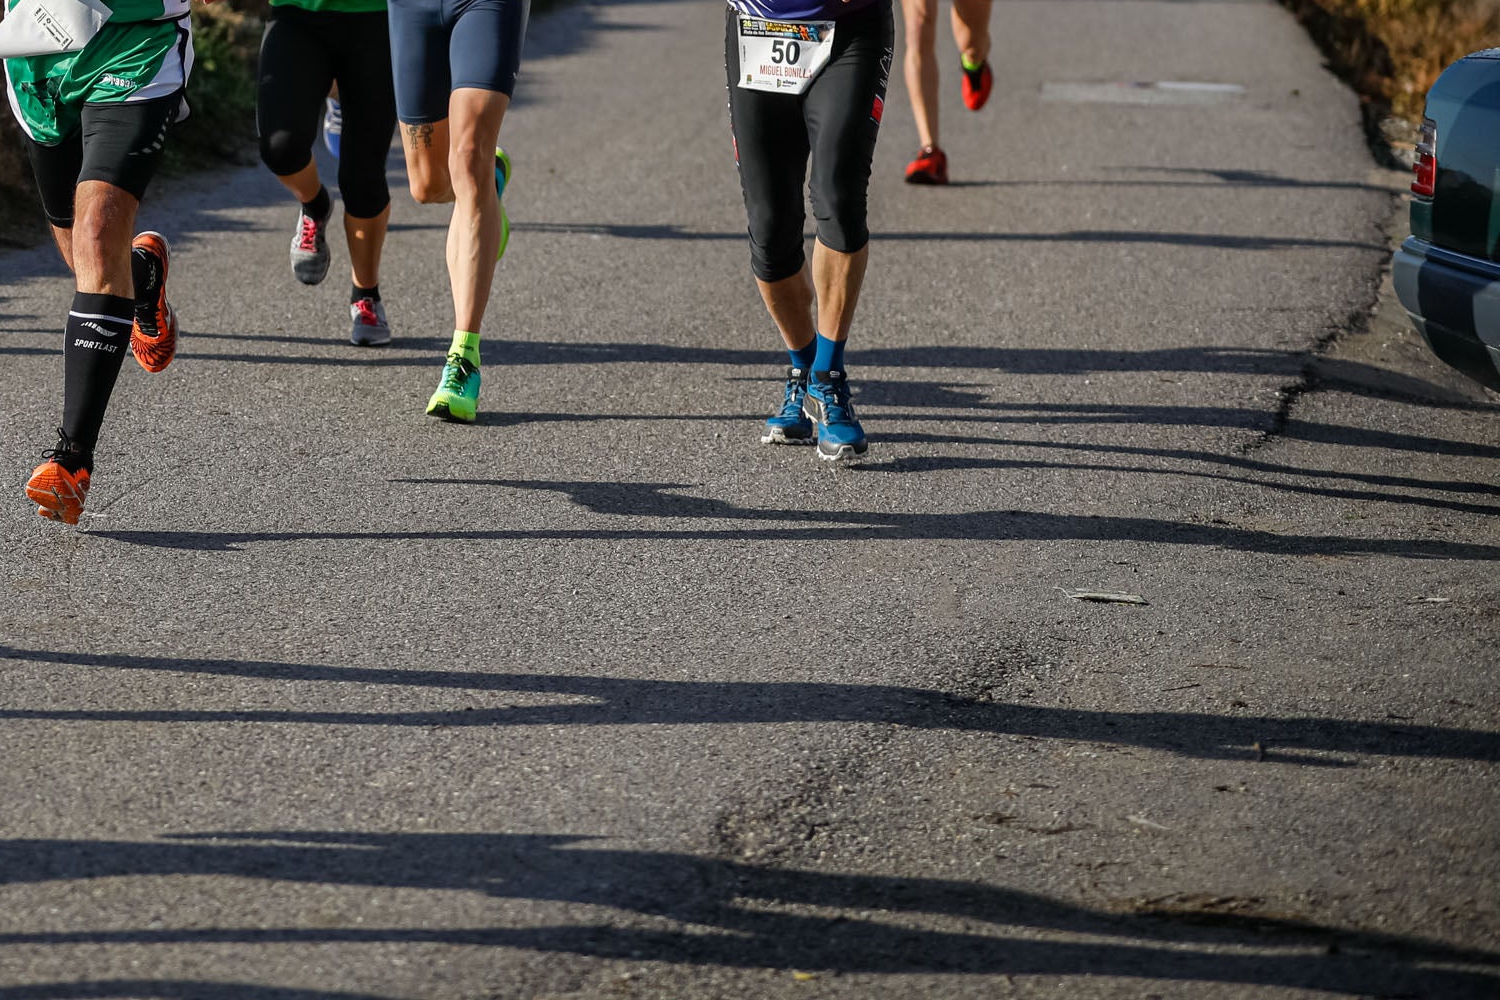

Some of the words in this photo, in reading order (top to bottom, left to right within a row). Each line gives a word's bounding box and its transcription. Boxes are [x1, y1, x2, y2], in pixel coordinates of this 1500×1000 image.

[771, 40, 801, 65] 50
[760, 65, 784, 76] MIGUEL
[74, 338, 119, 354] SPORTLAST
